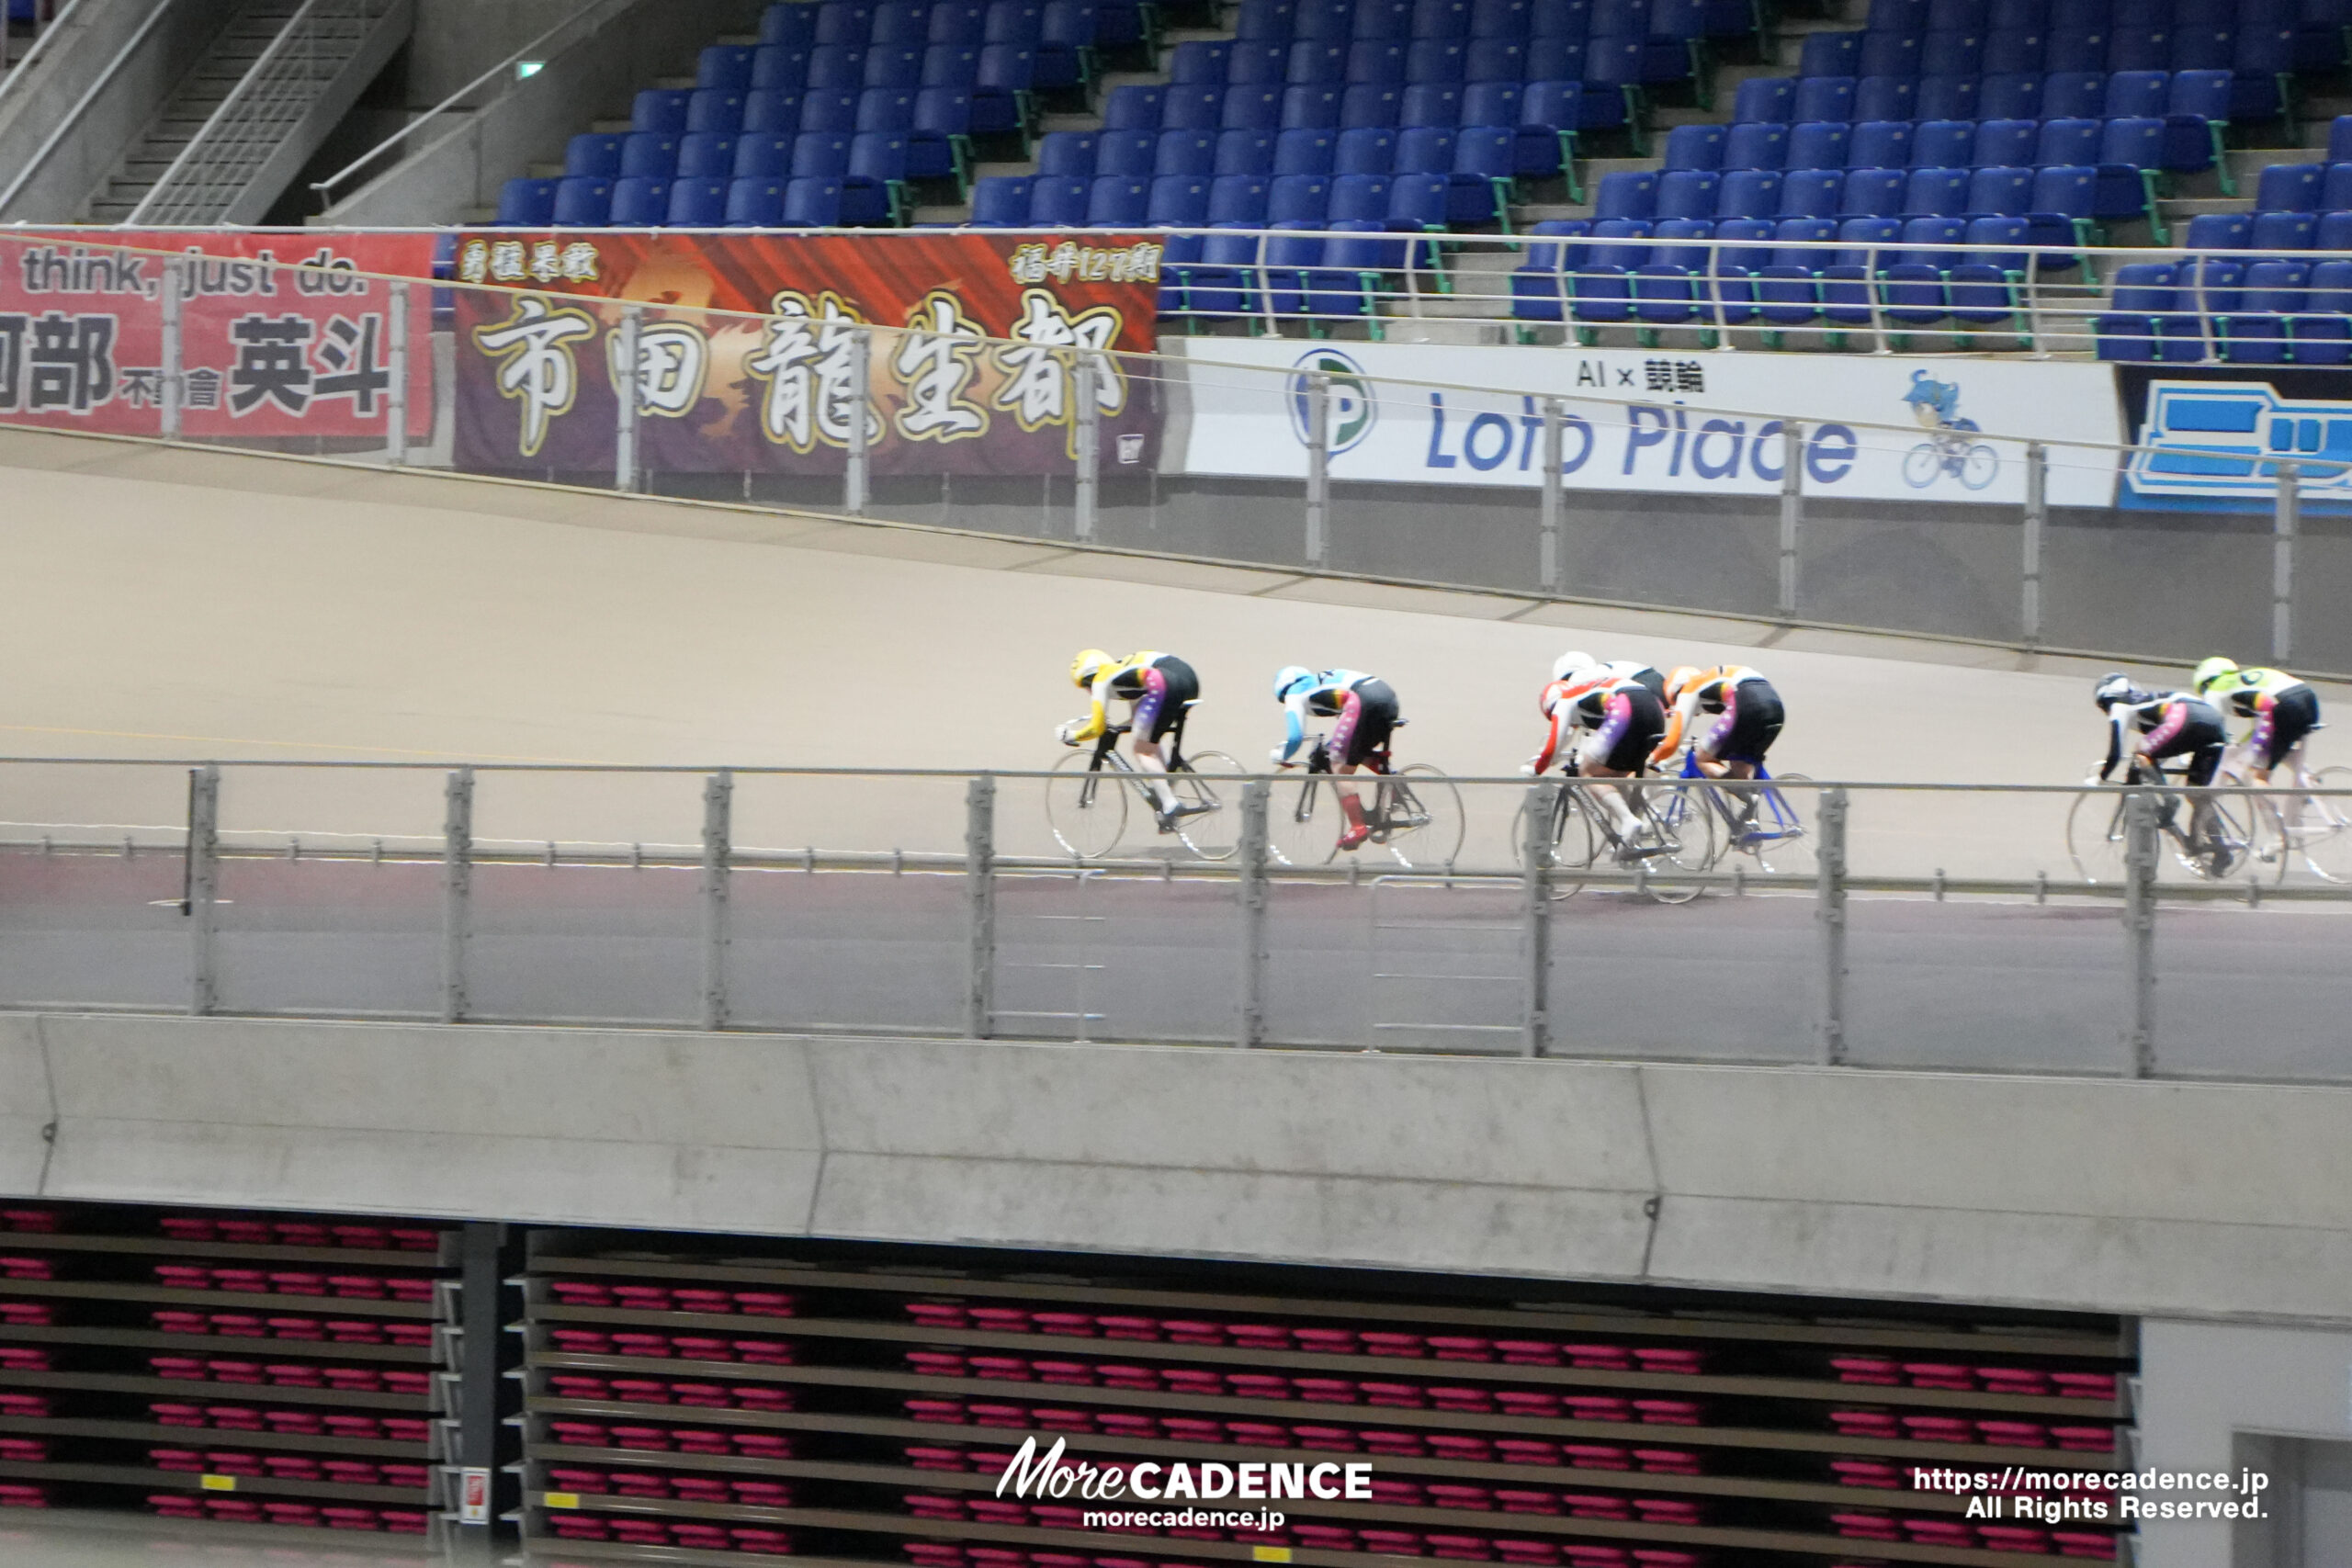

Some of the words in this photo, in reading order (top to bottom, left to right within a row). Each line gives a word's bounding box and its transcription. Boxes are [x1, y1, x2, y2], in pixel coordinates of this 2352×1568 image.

[24, 246, 157, 300] think,
[182, 247, 276, 299] just
[297, 248, 368, 295] do.
[1009, 242, 1163, 284] 福井127期
[1577, 360, 1606, 387] AI
[1645, 359, 1705, 392] 競輪
[1426, 392, 1594, 475] Loto
[1622, 400, 1858, 484] Place
